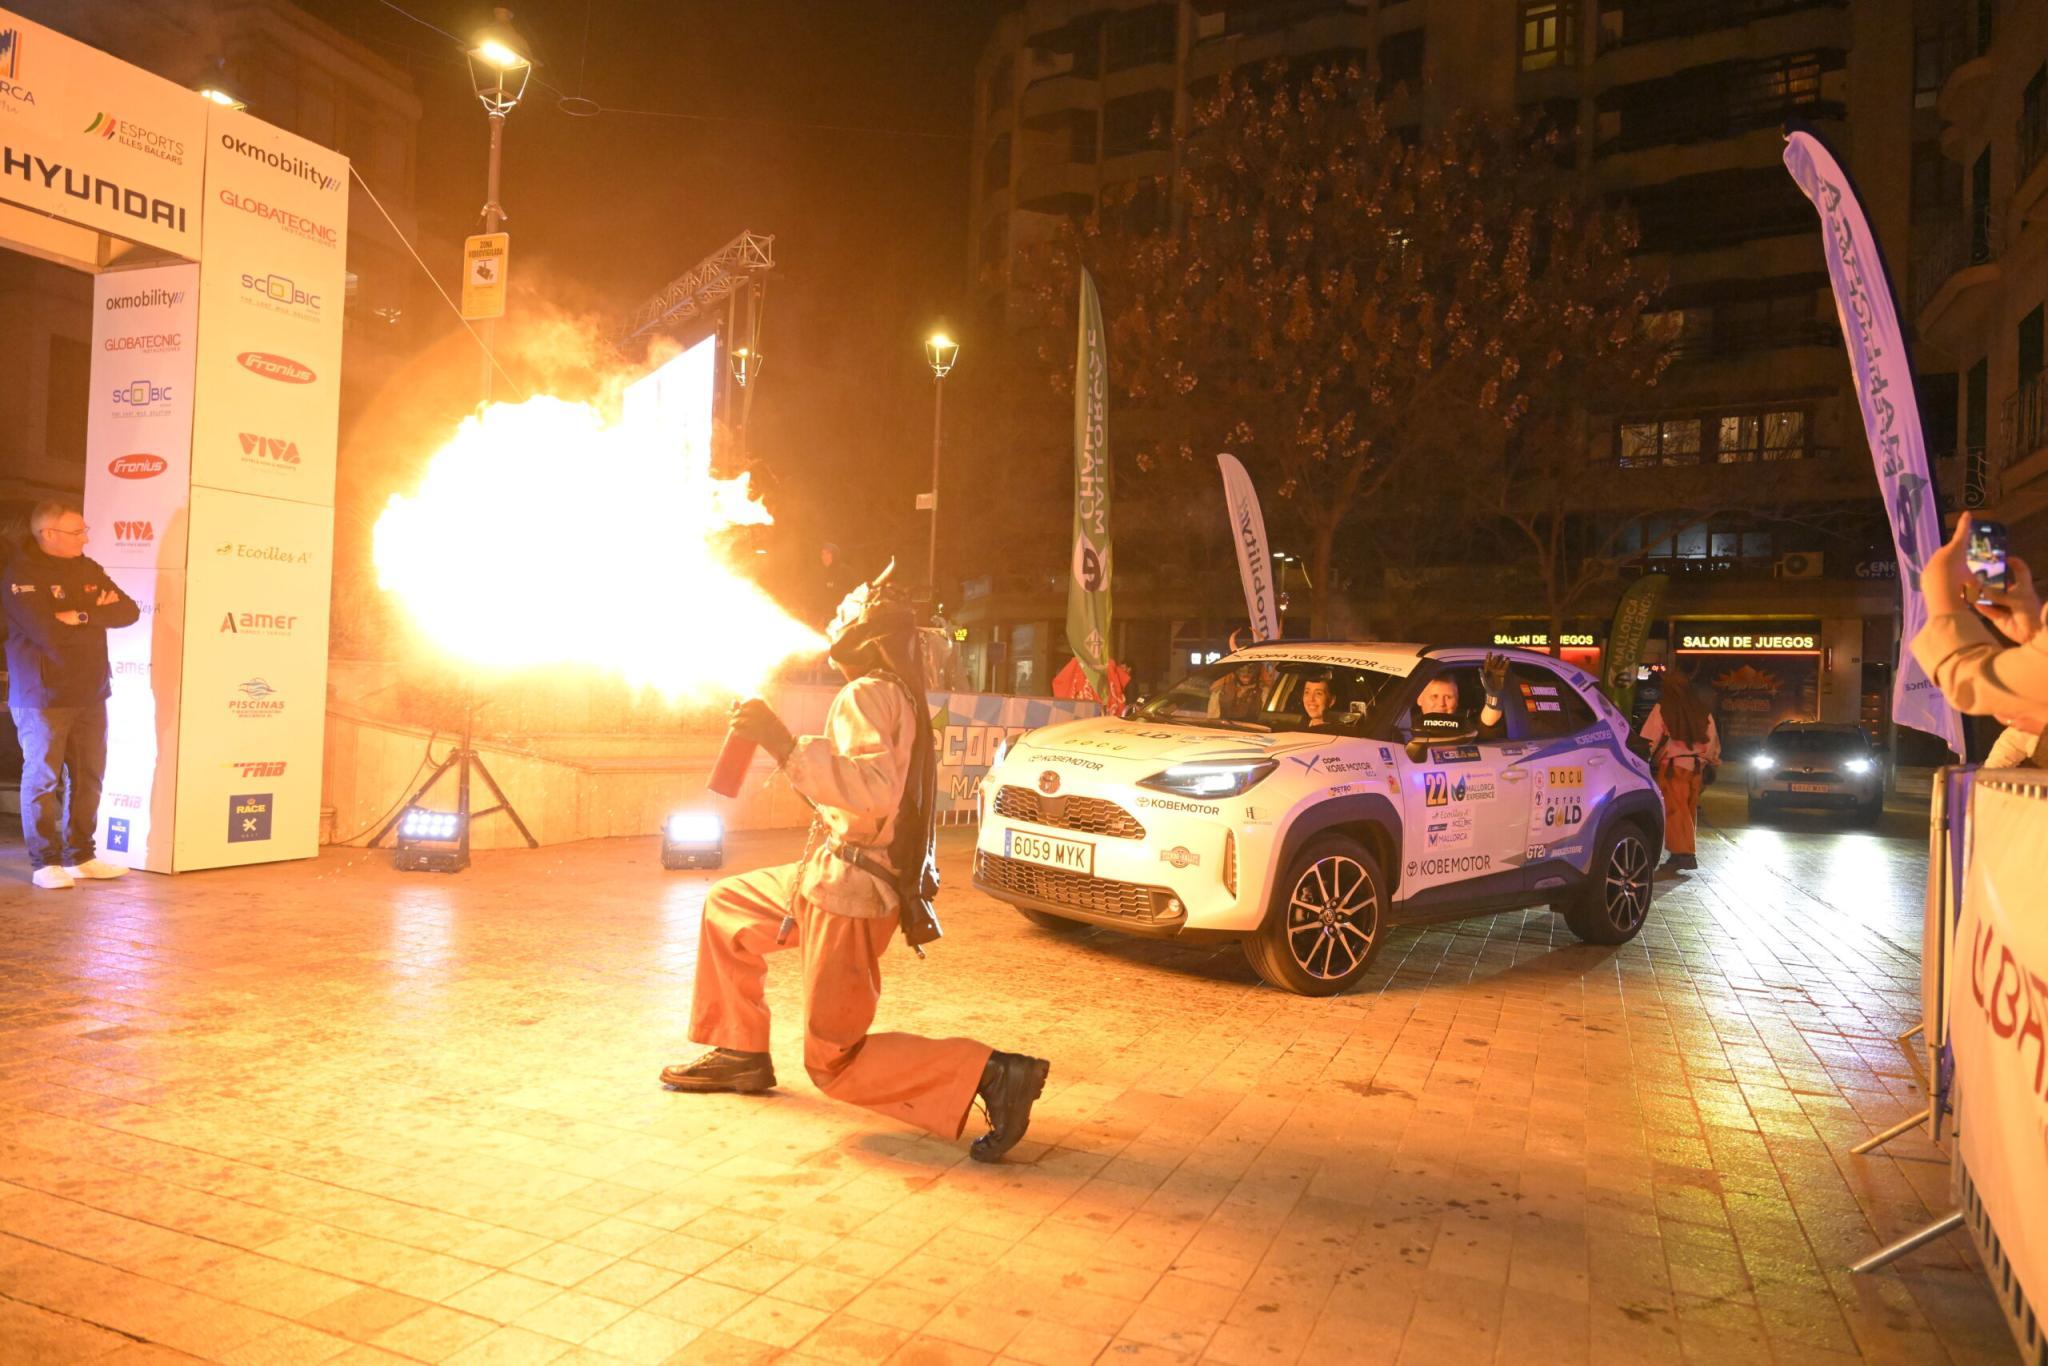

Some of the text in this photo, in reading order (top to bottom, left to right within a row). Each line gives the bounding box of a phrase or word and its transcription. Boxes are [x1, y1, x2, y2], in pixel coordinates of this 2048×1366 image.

[119, 120, 185, 156] ESPORTS
[118, 135, 184, 166] ILLES BALEARS
[4, 146, 186, 233] HYUNDAI
[219, 189, 337, 243] GLOBATECNIC
[104, 333, 182, 352] GLOBATECNIC
[245, 354, 311, 381] Fronius
[238, 432, 301, 465] VIVA
[113, 458, 163, 475] Fronius
[113, 521, 154, 541] VIVA
[1494, 634, 1530, 645] SALON
[1532, 634, 1548, 645] DE
[1683, 636, 1814, 648] SALON DE JUEGOS
[1326, 655, 1380, 668] MOTOR
[228, 700, 286, 710] PISCINAS
[1423, 719, 1459, 729] macron
[1550, 770, 1582, 784] DOCU
[1425, 771, 1448, 805] 22
[1466, 783, 1495, 792] MALLORCA
[1466, 792, 1496, 801] EXPERIENCE
[236, 804, 267, 815] RACE
[1150, 798, 1220, 816] KOBEMOTOR
[1014, 836, 1086, 868] 6059 MYK
